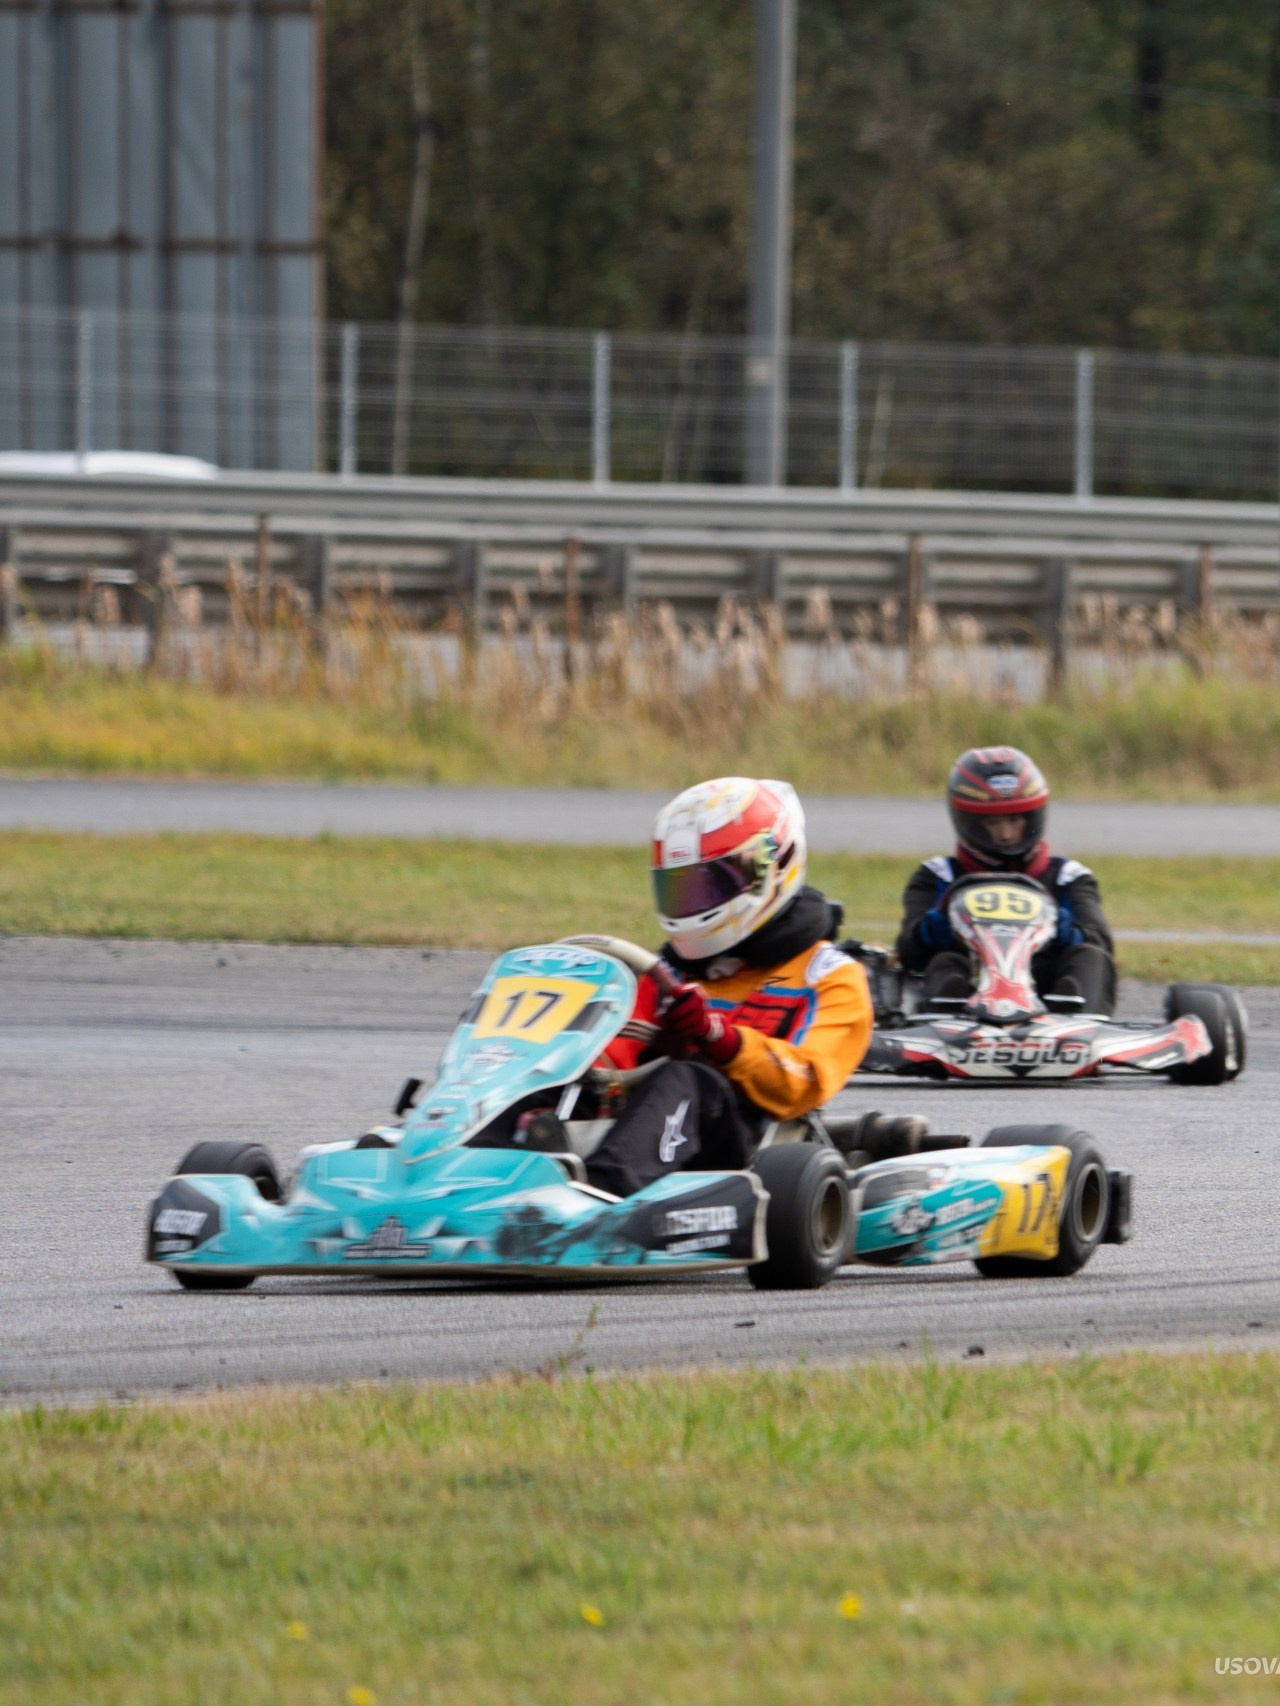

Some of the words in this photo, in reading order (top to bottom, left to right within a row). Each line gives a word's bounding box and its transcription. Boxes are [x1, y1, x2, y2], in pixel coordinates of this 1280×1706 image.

[974, 891, 1032, 915] 95
[496, 989, 565, 1030] 17
[957, 1042, 1086, 1065] JESOLO
[1016, 1172, 1053, 1235] 17
